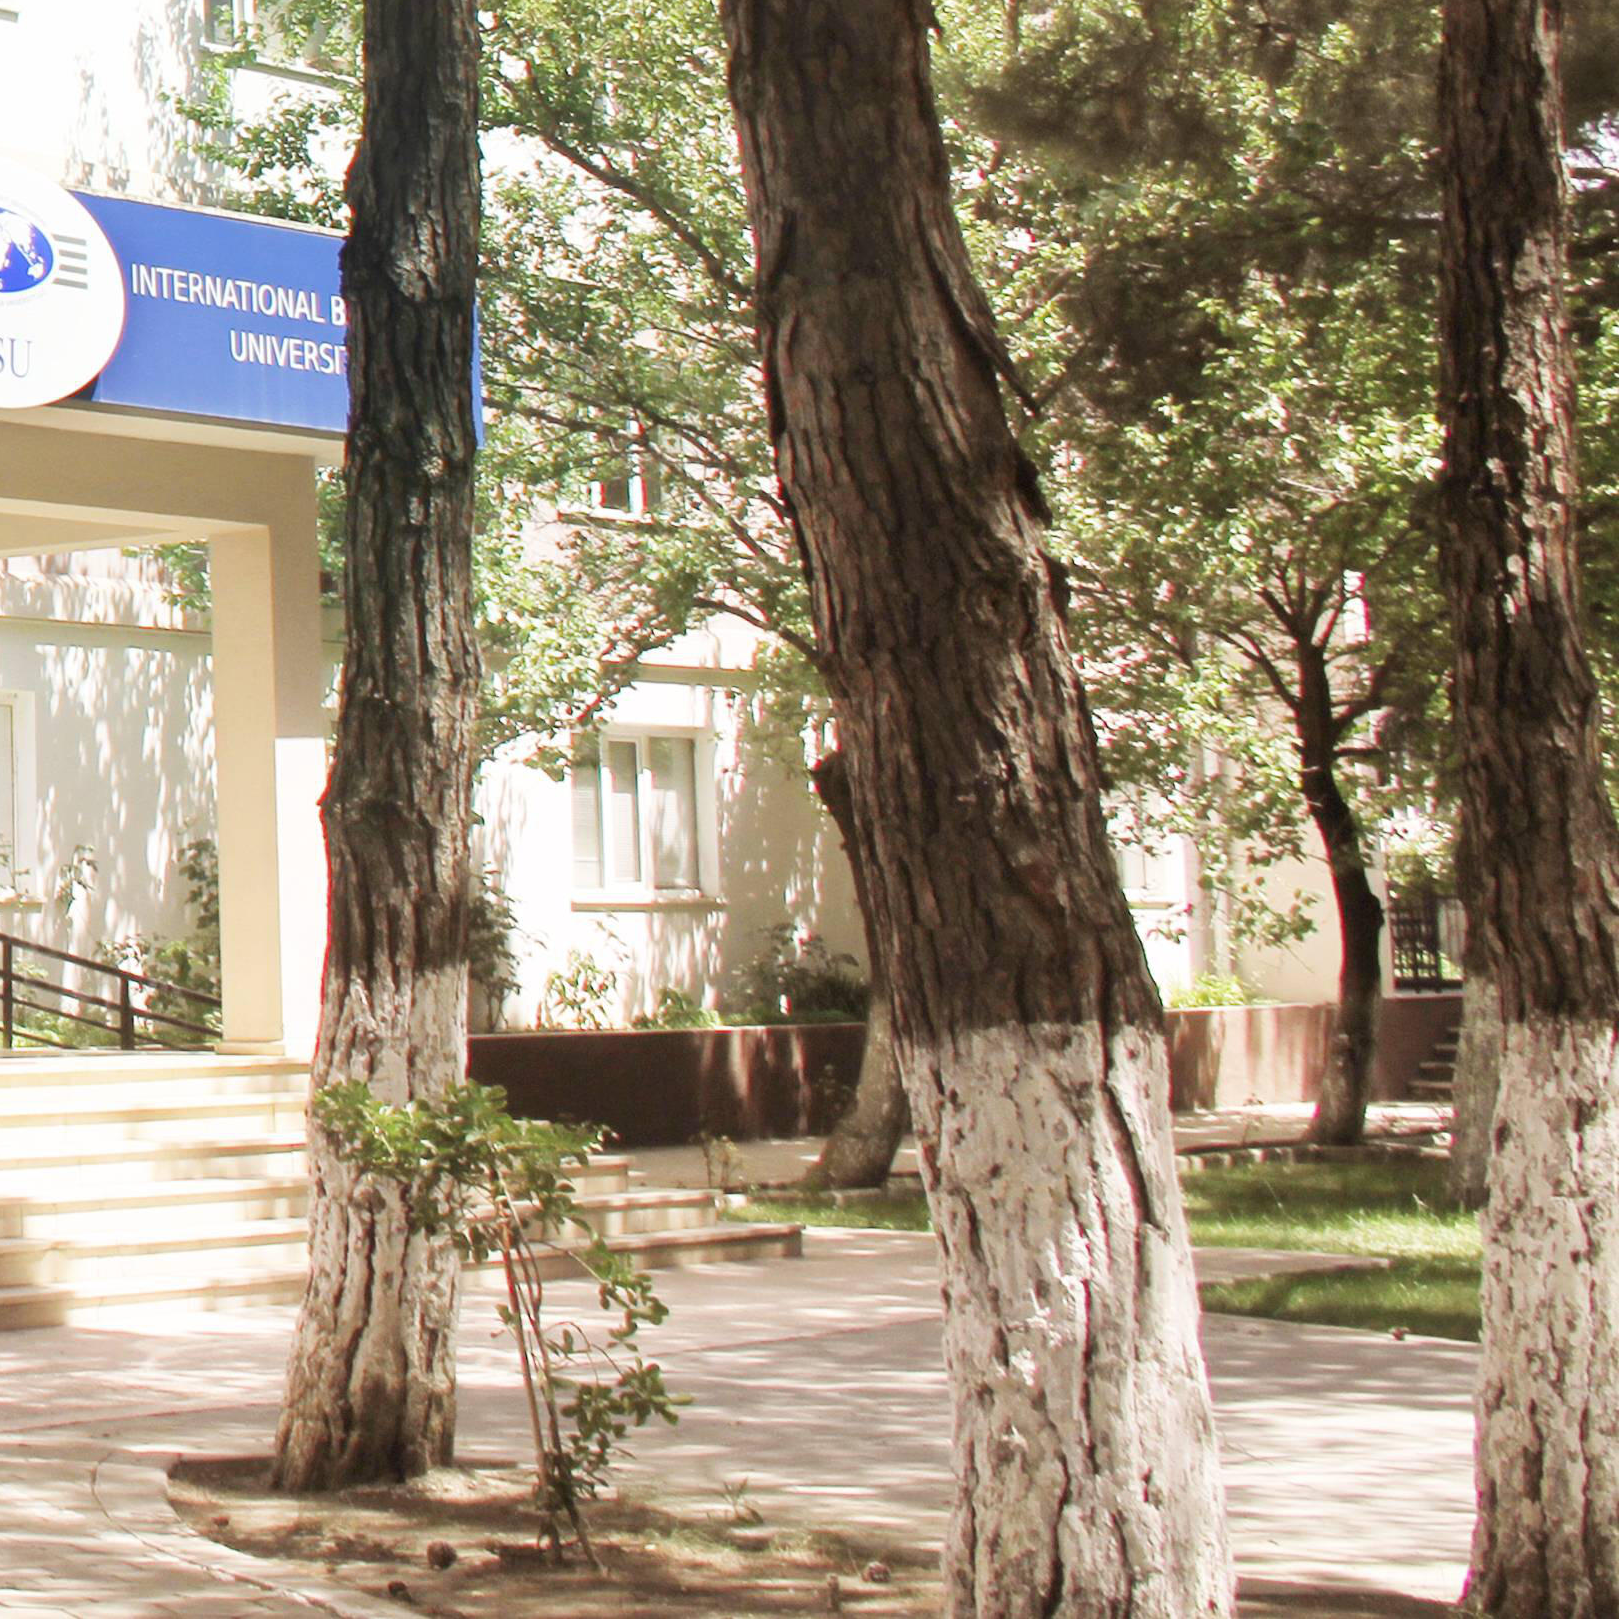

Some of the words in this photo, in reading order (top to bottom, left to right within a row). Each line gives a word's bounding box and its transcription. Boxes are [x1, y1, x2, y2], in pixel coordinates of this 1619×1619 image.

[131, 263, 326, 324] INTERNATIONAL
[330, 295, 347, 326] B
[230, 329, 347, 375] UNIVERSI
